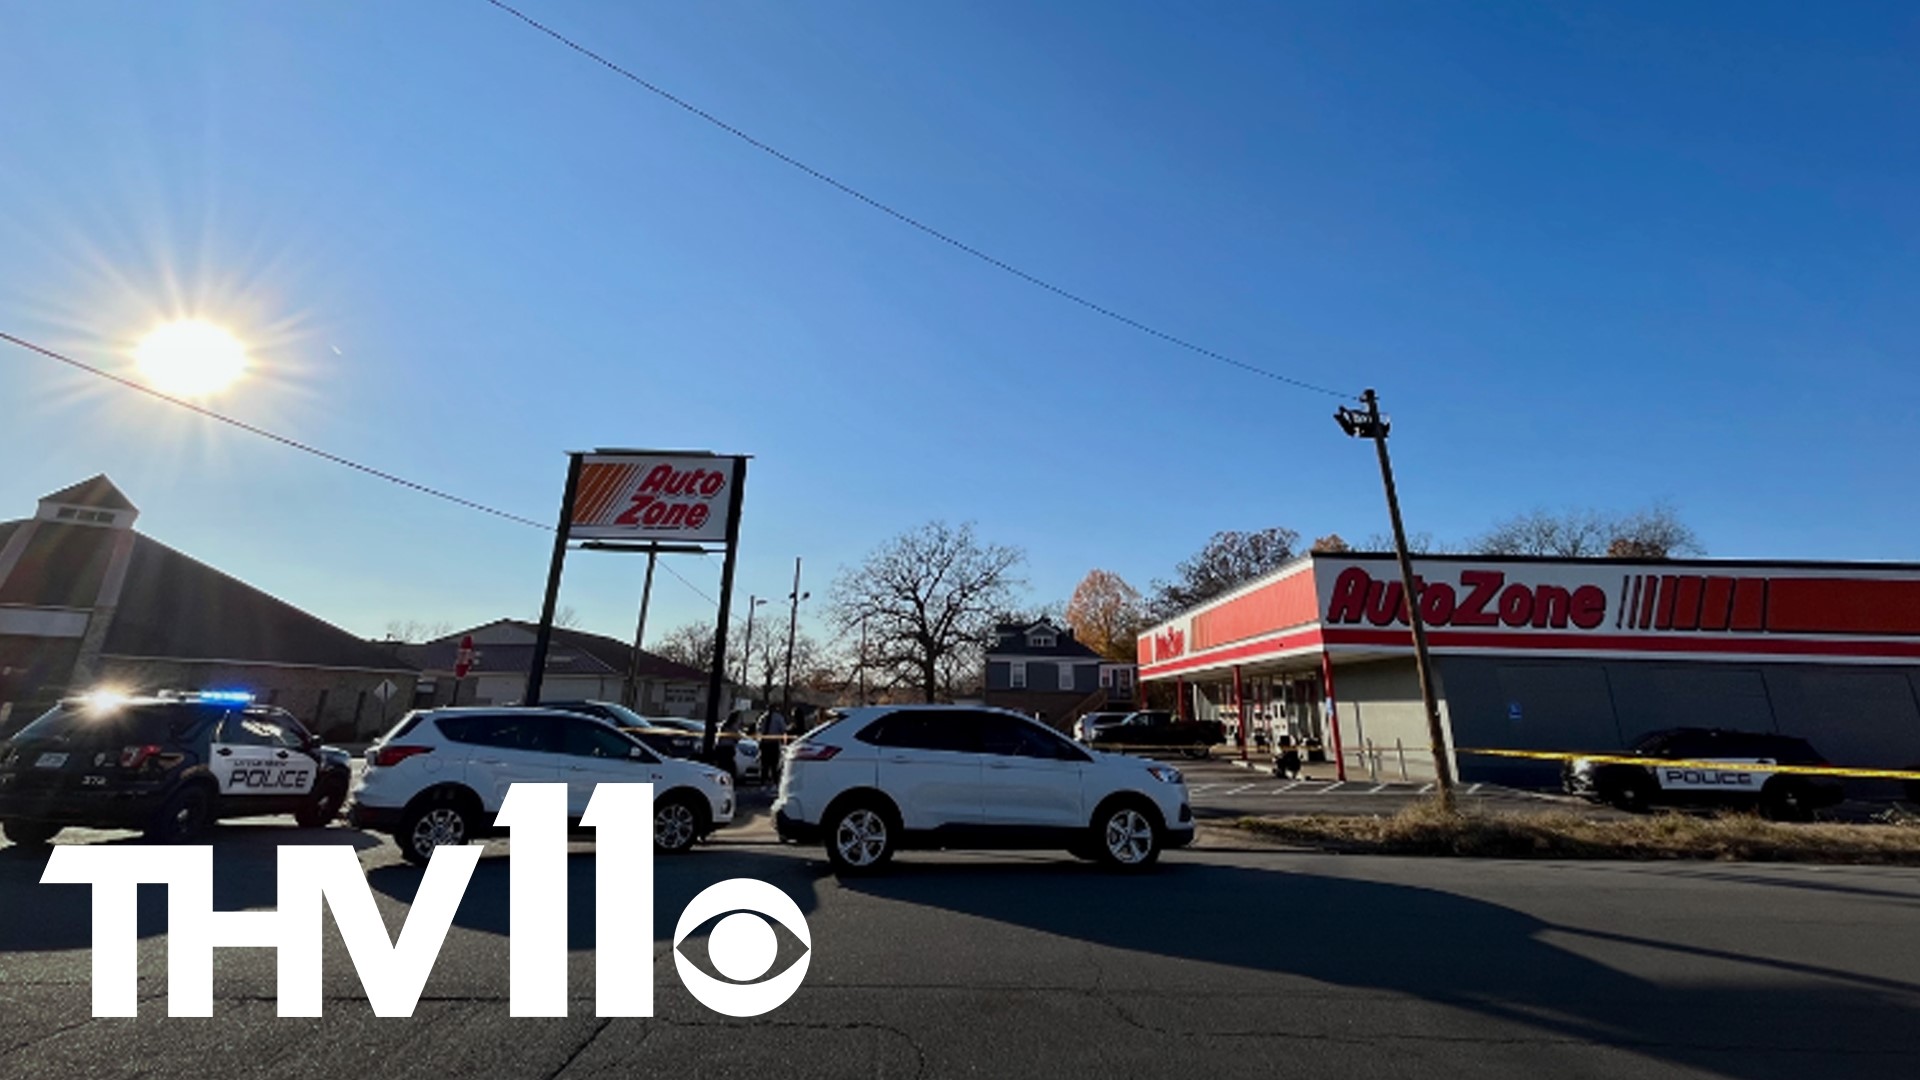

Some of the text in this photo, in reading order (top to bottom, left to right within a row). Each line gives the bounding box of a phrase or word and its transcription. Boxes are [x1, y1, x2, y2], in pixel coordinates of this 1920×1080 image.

[636, 463, 726, 499] Auto
[614, 494, 710, 530] Zone
[1326, 566, 1607, 630] AutoZone
[228, 769, 309, 788] POLICE
[1666, 770, 1752, 785] POLICE
